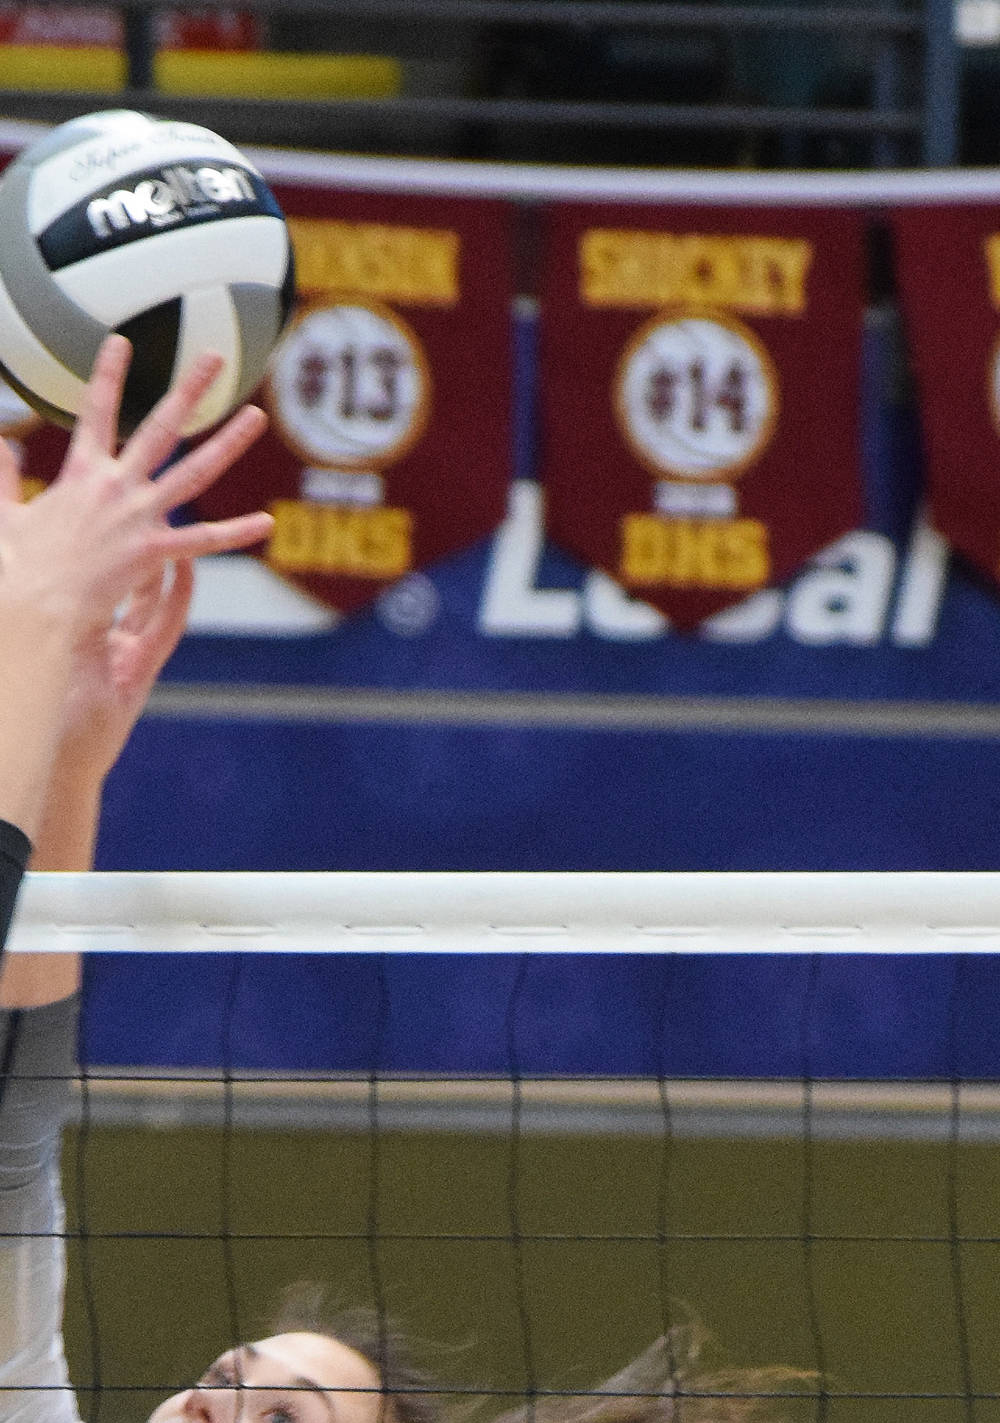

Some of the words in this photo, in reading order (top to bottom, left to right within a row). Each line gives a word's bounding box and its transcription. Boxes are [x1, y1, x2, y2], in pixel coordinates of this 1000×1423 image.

[85, 165, 257, 241] molten
[296, 343, 406, 421] #13
[646, 352, 750, 434] #14
